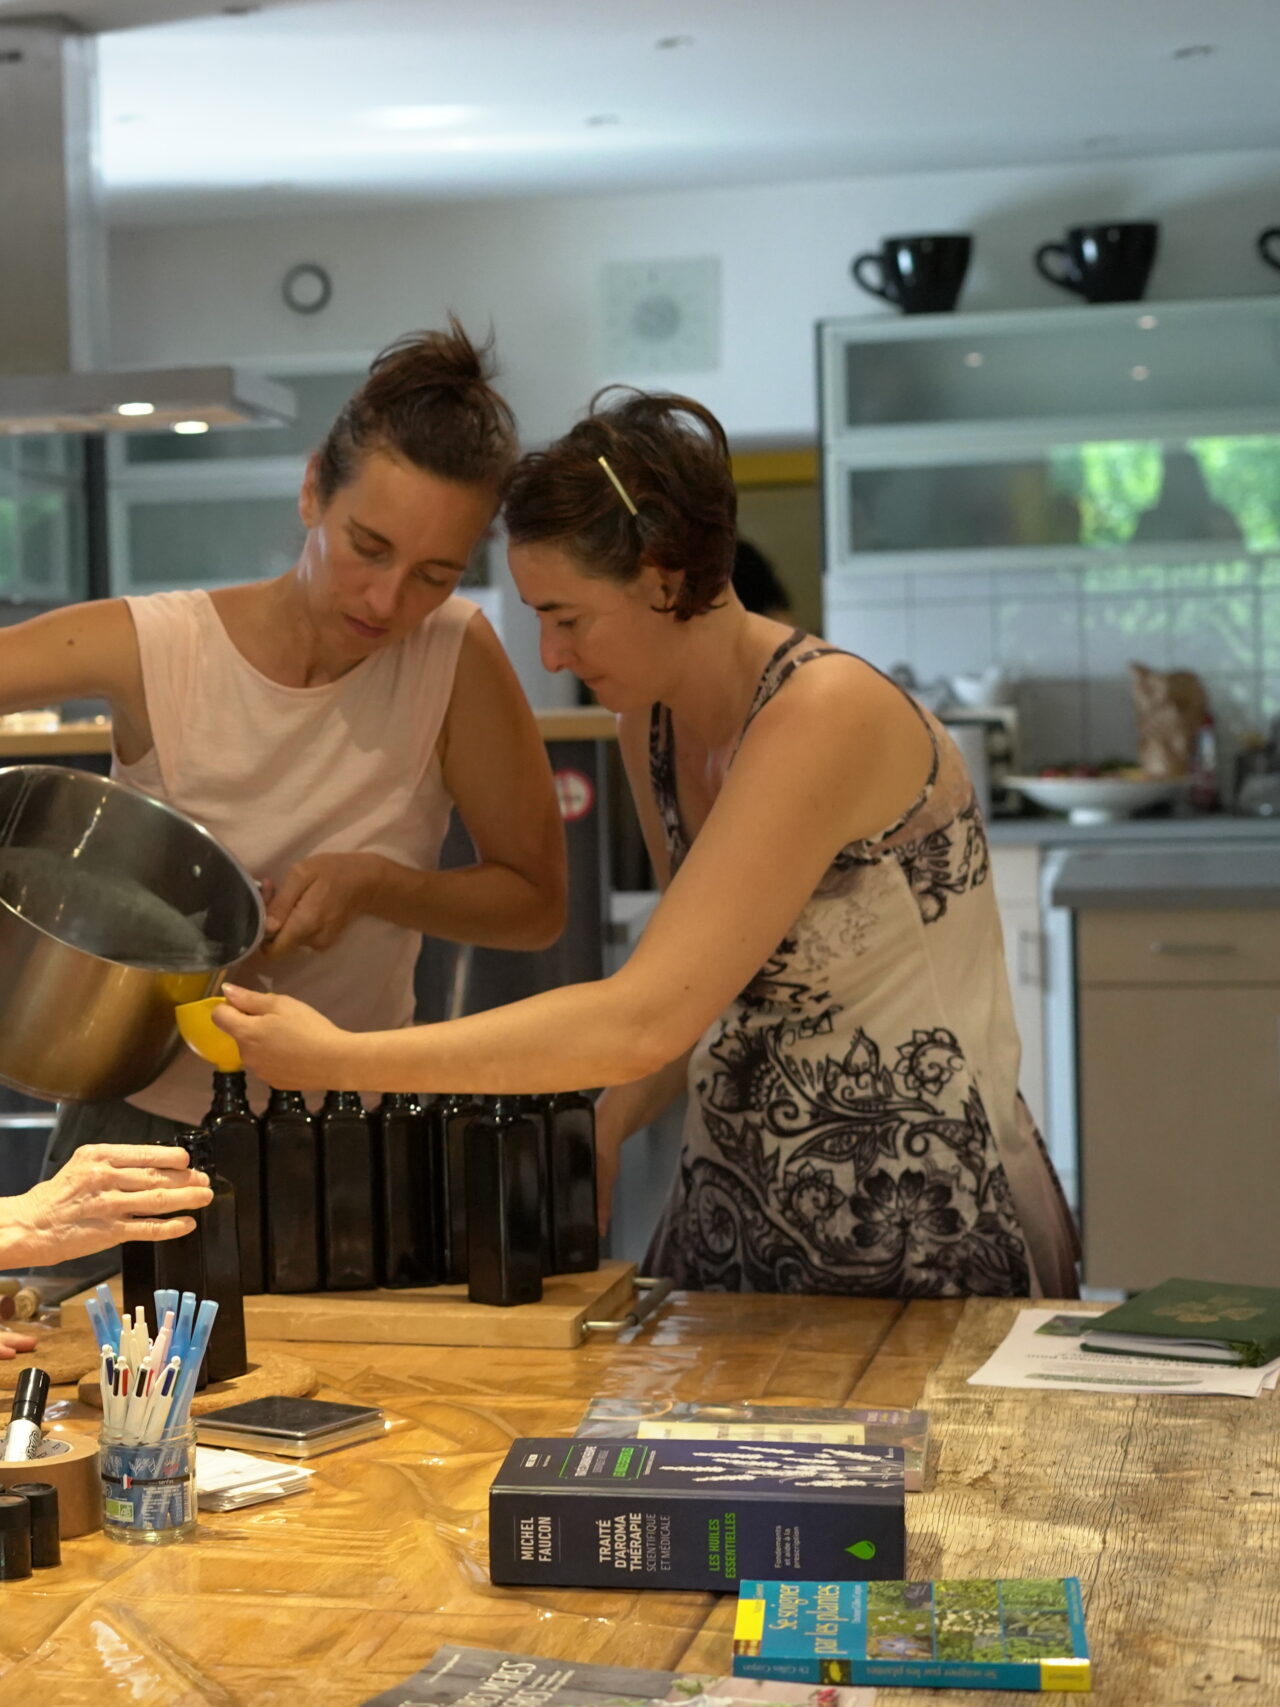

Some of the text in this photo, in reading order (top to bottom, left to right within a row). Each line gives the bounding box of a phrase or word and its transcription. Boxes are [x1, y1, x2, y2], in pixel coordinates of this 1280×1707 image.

[521, 1517, 534, 1560] MICHEL
[538, 1516, 552, 1562] FAUCON
[596, 1519, 611, 1562] TRAITÉ
[615, 1515, 626, 1568] D'AROMA
[627, 1513, 642, 1572] THÉRAPIE
[646, 1513, 657, 1572] SCIENTIFIQUE
[659, 1515, 671, 1571] ET MÉDICALE
[708, 1519, 720, 1571] LES HUILES
[725, 1512, 736, 1578] ESSENTIELLES
[768, 1584, 808, 1630] Se soigner
[804, 1585, 849, 1654] par les plantes
